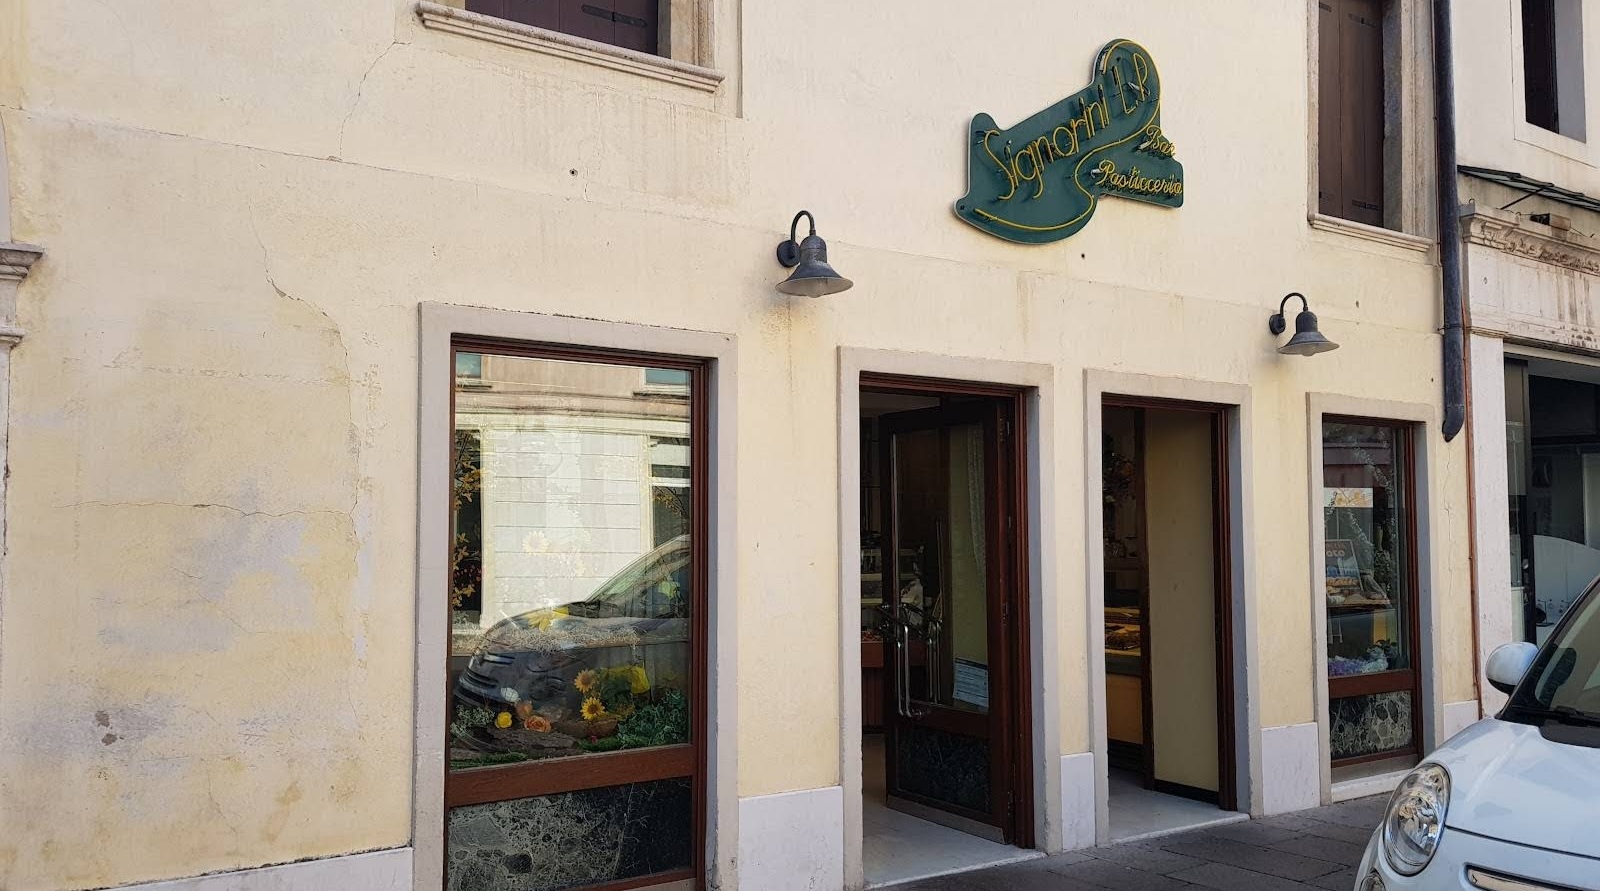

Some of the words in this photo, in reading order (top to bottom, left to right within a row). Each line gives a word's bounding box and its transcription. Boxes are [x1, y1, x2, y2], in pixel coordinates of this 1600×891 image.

[984, 84, 1109, 199] Signorini
[1146, 125, 1176, 156] Bar
[1096, 159, 1183, 195] Pasticceria
